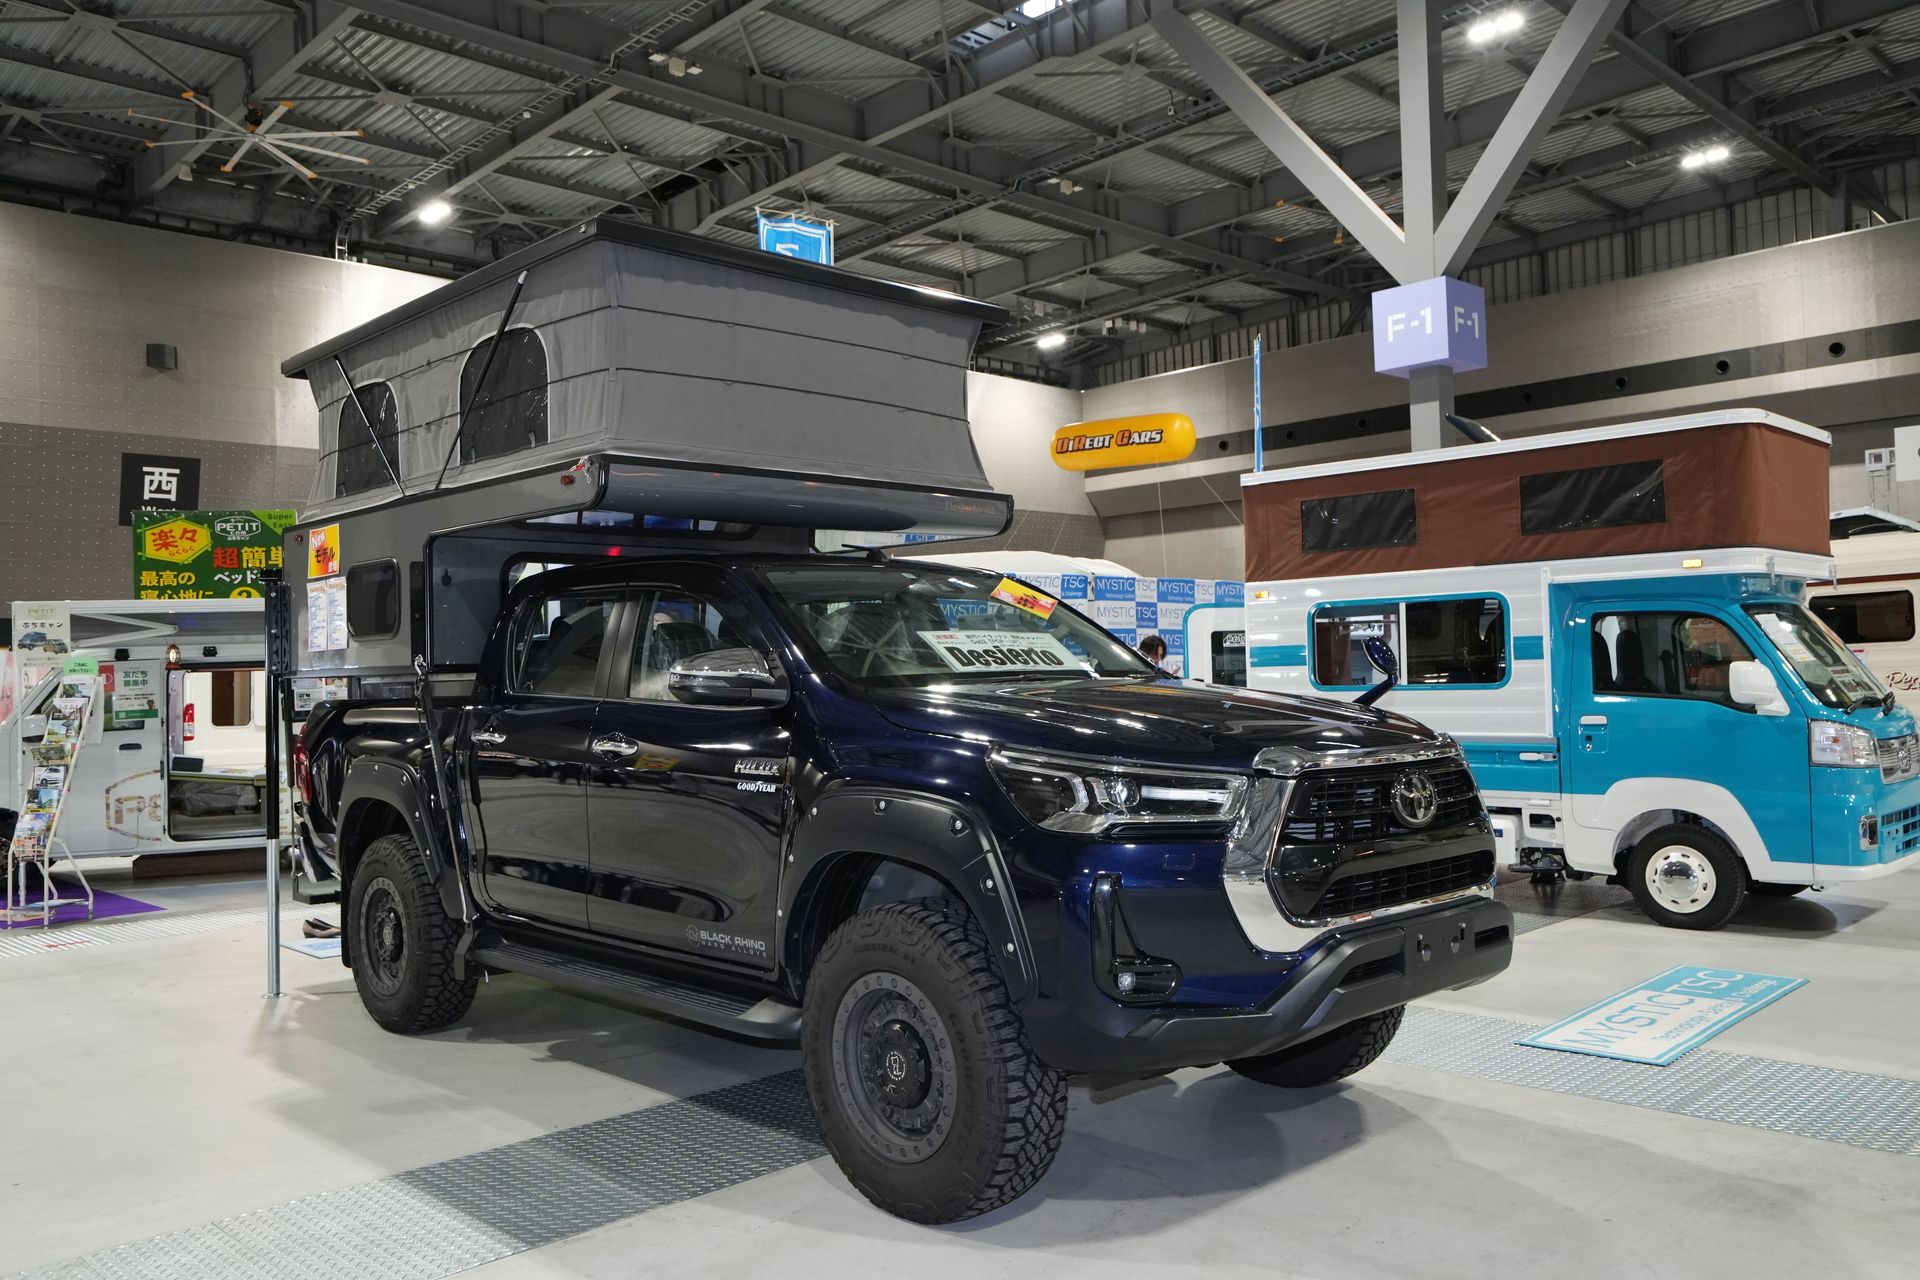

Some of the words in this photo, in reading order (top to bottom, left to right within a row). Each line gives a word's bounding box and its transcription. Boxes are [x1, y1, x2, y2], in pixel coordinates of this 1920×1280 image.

[1387, 306, 1433, 343] F-1
[1454, 305, 1479, 339] F-1
[142, 466, 180, 502] 西
[217, 522, 259, 532] PETIT
[150, 527, 198, 552] 楽々
[168, 545, 196, 557] らくらく
[140, 571, 196, 587] 最高の
[1063, 576, 1085, 588] TSC
[1097, 579, 1134, 591] MYSTIC
[1136, 580, 1156, 592] TSC
[1159, 581, 1194, 594] MYSTIC
[1196, 584, 1214, 595] TSC
[1216, 584, 1245, 596] MYSTI
[940, 604, 987, 616] MYSTIC
[1097, 606, 1135, 618] MYSTIC
[1136, 606, 1157, 619] TSC
[944, 645, 1065, 668] Desierto
[123, 670, 148, 679] 友だち
[123, 679, 148, 687] 募集中
[700, 930, 732, 945] BLACK
[734, 936, 766, 951] RHINO
[702, 940, 725, 949] HARD
[731, 946, 767, 958] ALLOYS
[1561, 994, 1696, 1048] MYSTIC
[1665, 970, 1744, 996] TSC
